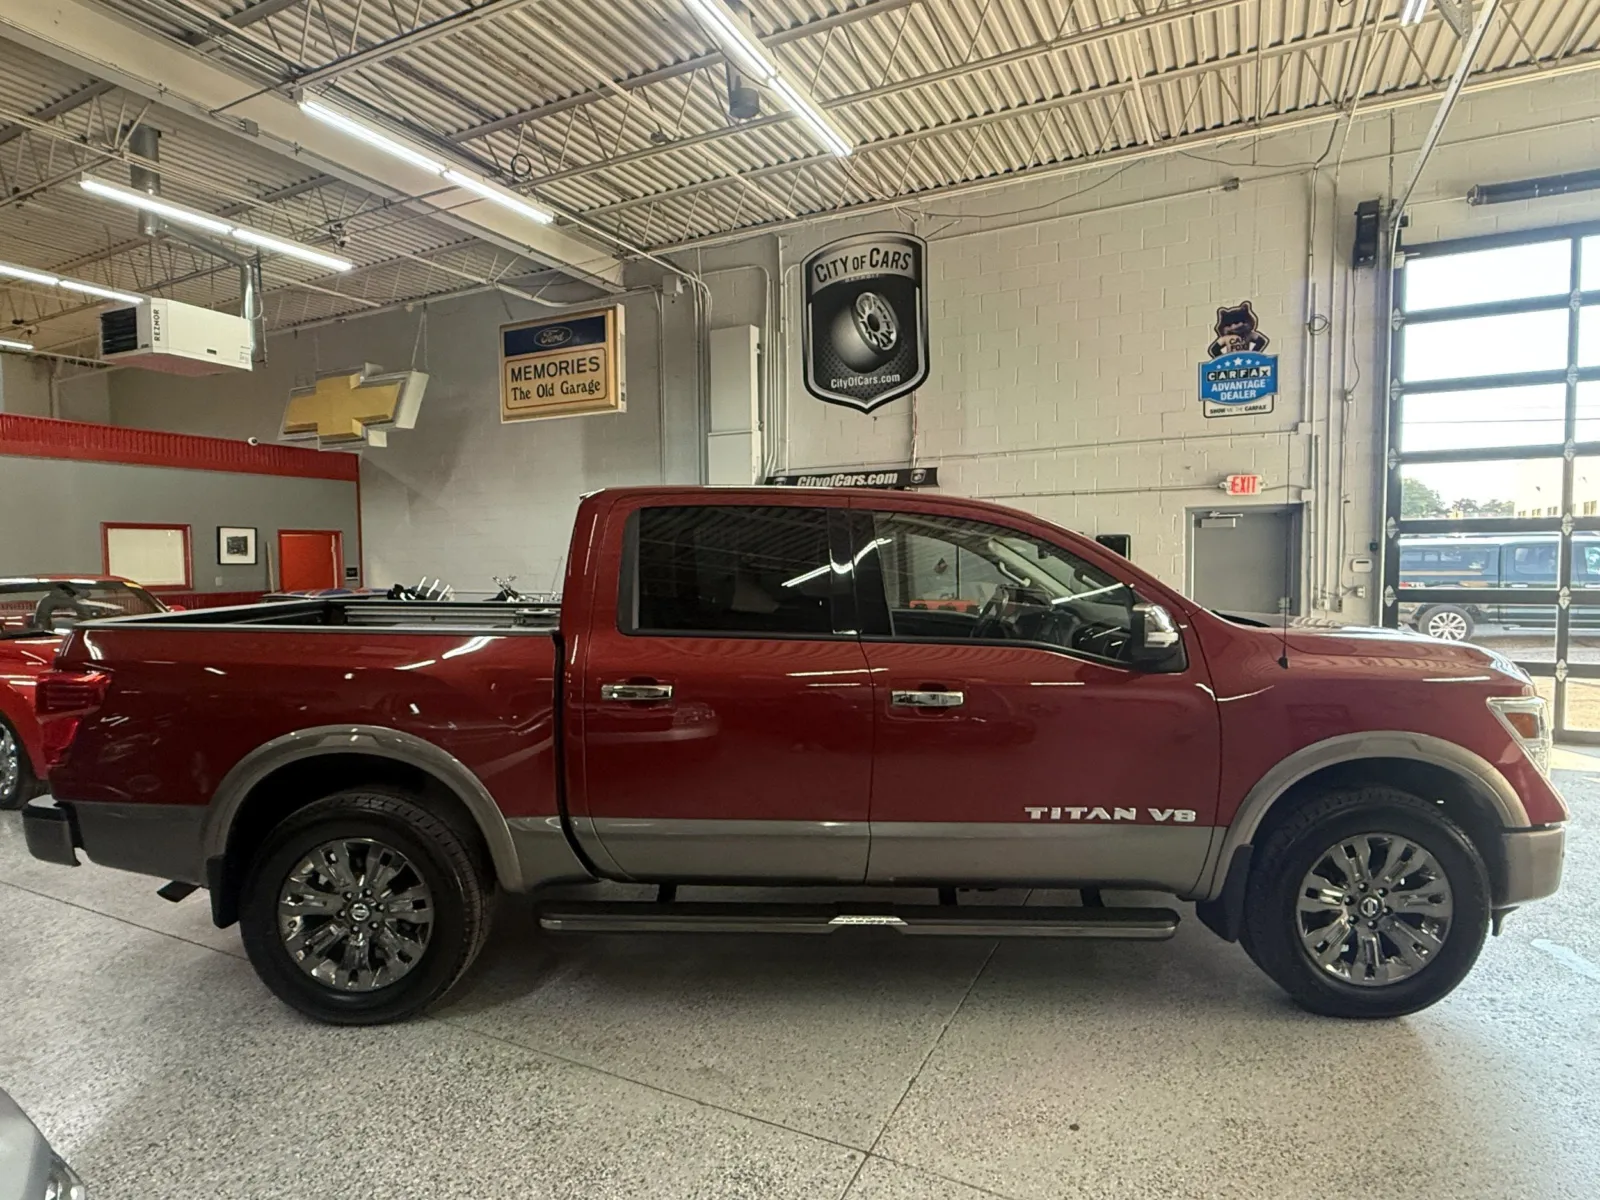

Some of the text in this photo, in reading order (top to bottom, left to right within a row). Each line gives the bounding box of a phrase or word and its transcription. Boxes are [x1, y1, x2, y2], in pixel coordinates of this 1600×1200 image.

[153, 308, 161, 342] REZNOR
[540, 328, 566, 344] Ford
[511, 356, 601, 383] MEMORIES
[1208, 368, 1270, 381] CARFAX
[830, 373, 901, 389] CityOfCars.com
[1211, 379, 1266, 392] ADVANTAGE
[511, 380, 601, 401] The Old Garage
[1220, 390, 1257, 400] DEALER
[797, 472, 898, 487] CityofCars.com
[1232, 476, 1257, 493] EXIT
[1024, 806, 1197, 822] TITAN V8
